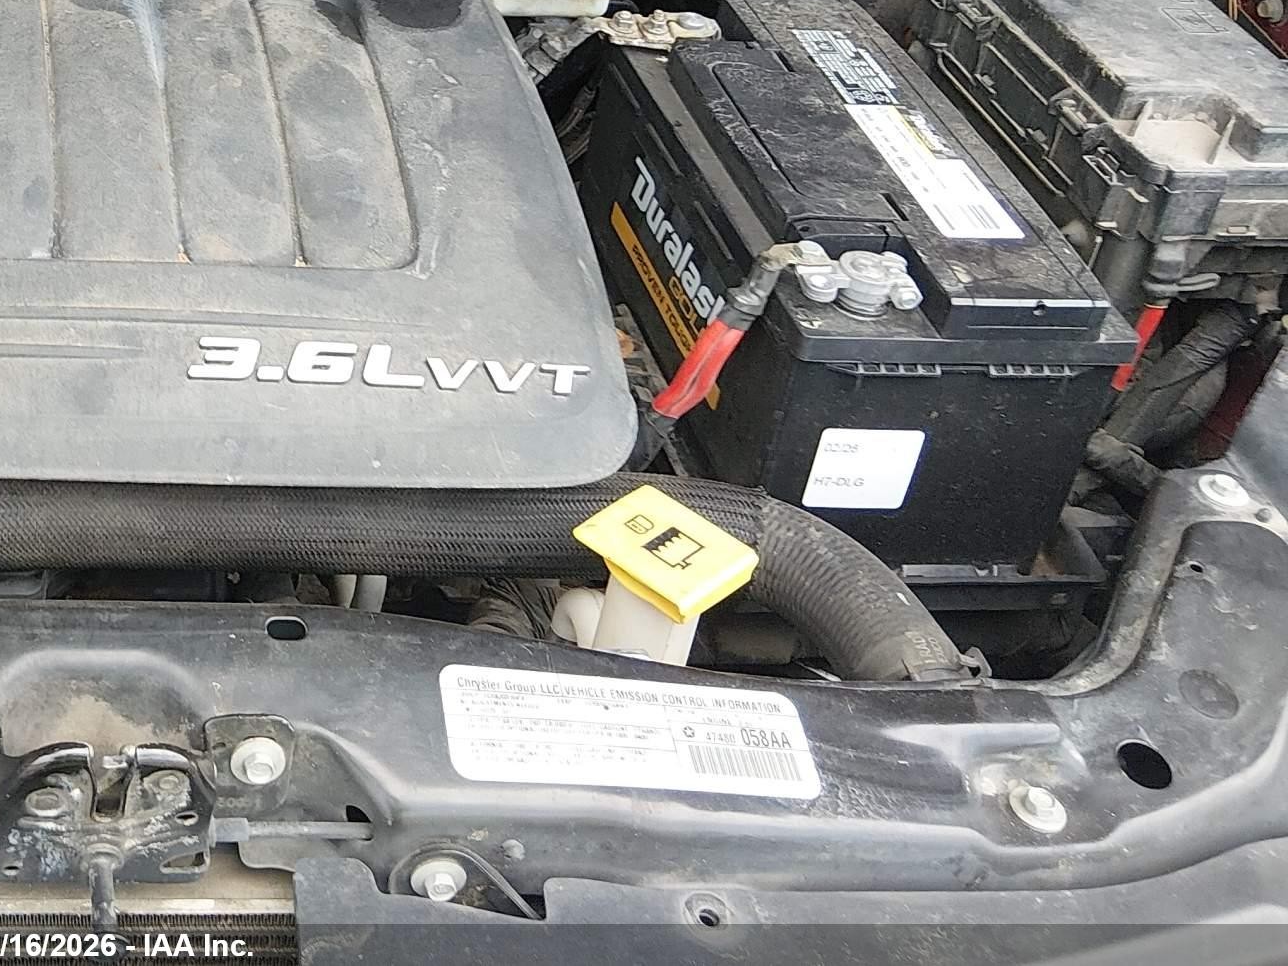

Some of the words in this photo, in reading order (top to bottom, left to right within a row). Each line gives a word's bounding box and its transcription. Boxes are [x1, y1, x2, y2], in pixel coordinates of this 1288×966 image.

[668, 275, 705, 339] GOL
[187, 336, 425, 388] 3.6L
[426, 356, 591, 396] VVT
[456, 676, 502, 693] Chrysler
[504, 679, 537, 697] Group
[539, 682, 561, 696] LLC
[563, 684, 607, 700] VEHICLE
[610, 688, 659, 705] EMISSION
[661, 693, 707, 708] CONTROL
[711, 697, 782, 715] INFORMATION
[740, 726, 792, 750] 058AA
